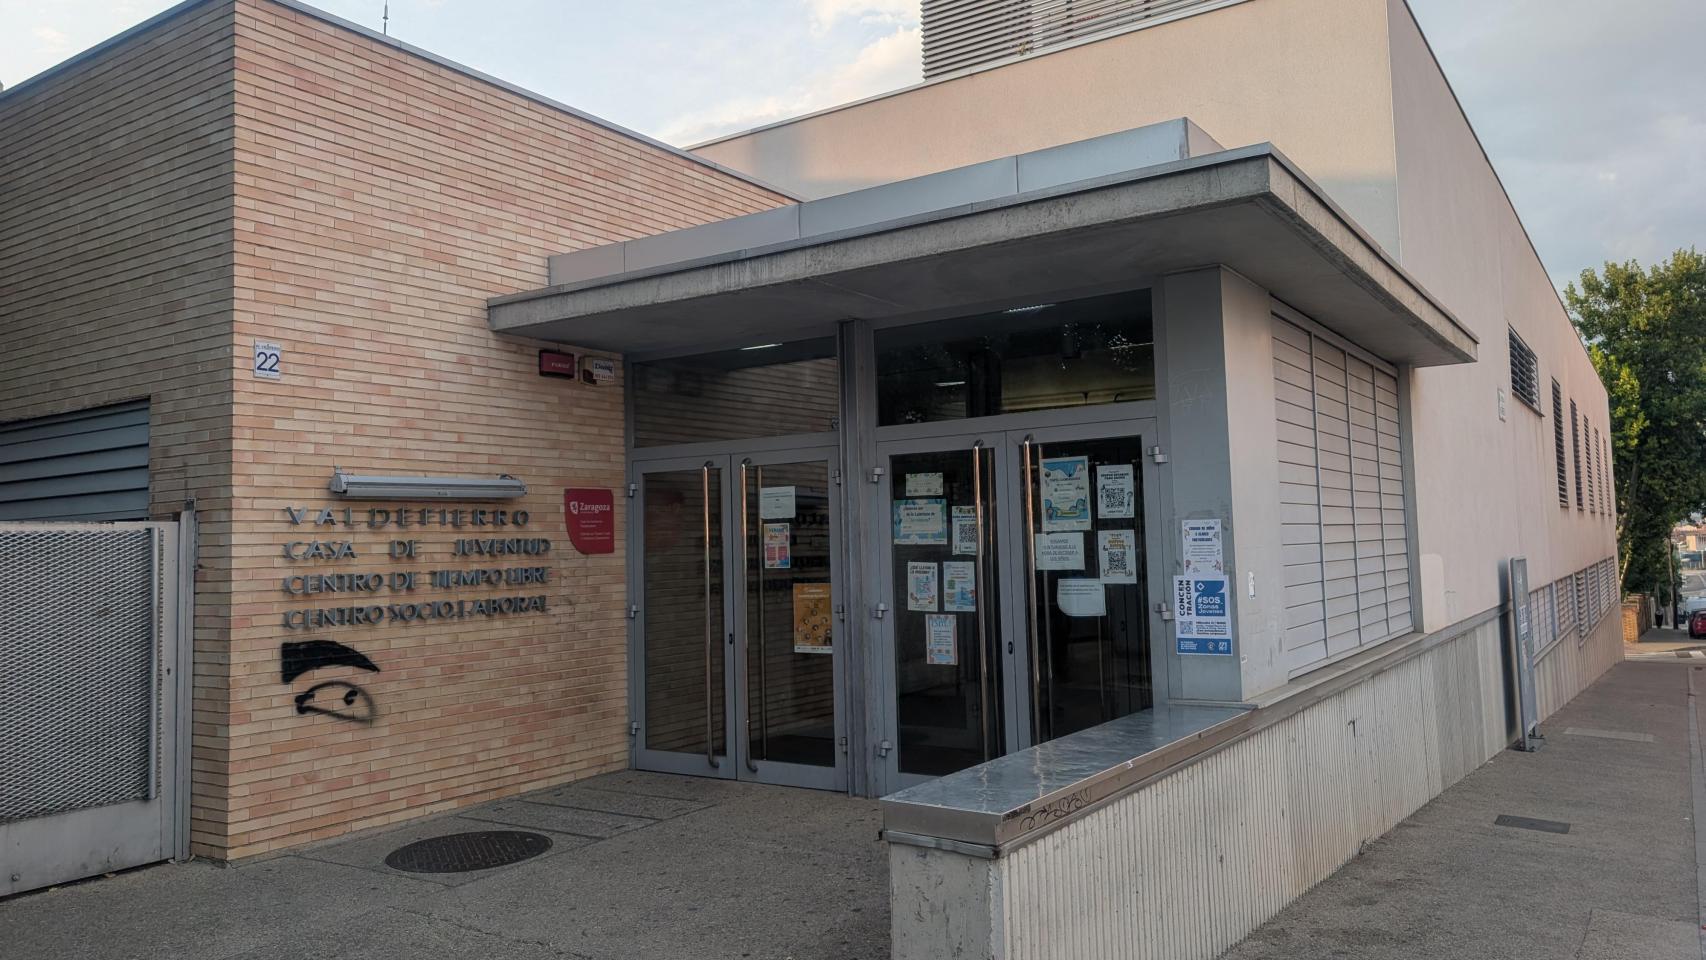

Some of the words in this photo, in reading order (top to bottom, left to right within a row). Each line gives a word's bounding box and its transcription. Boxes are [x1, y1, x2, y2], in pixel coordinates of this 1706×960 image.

[257, 351, 280, 373] 22
[283, 506, 529, 529] VALDEFIERRO
[579, 502, 610, 514] Zaragoza
[283, 540, 357, 561] CASA
[390, 539, 421, 559] DE
[452, 537, 552, 557] JUVENTUD
[283, 572, 384, 595] CENTRO
[390, 571, 421, 591] DE
[430, 568, 503, 590] TIEMPO
[505, 566, 552, 586] LIBRE
[283, 605, 385, 630] CENTRO
